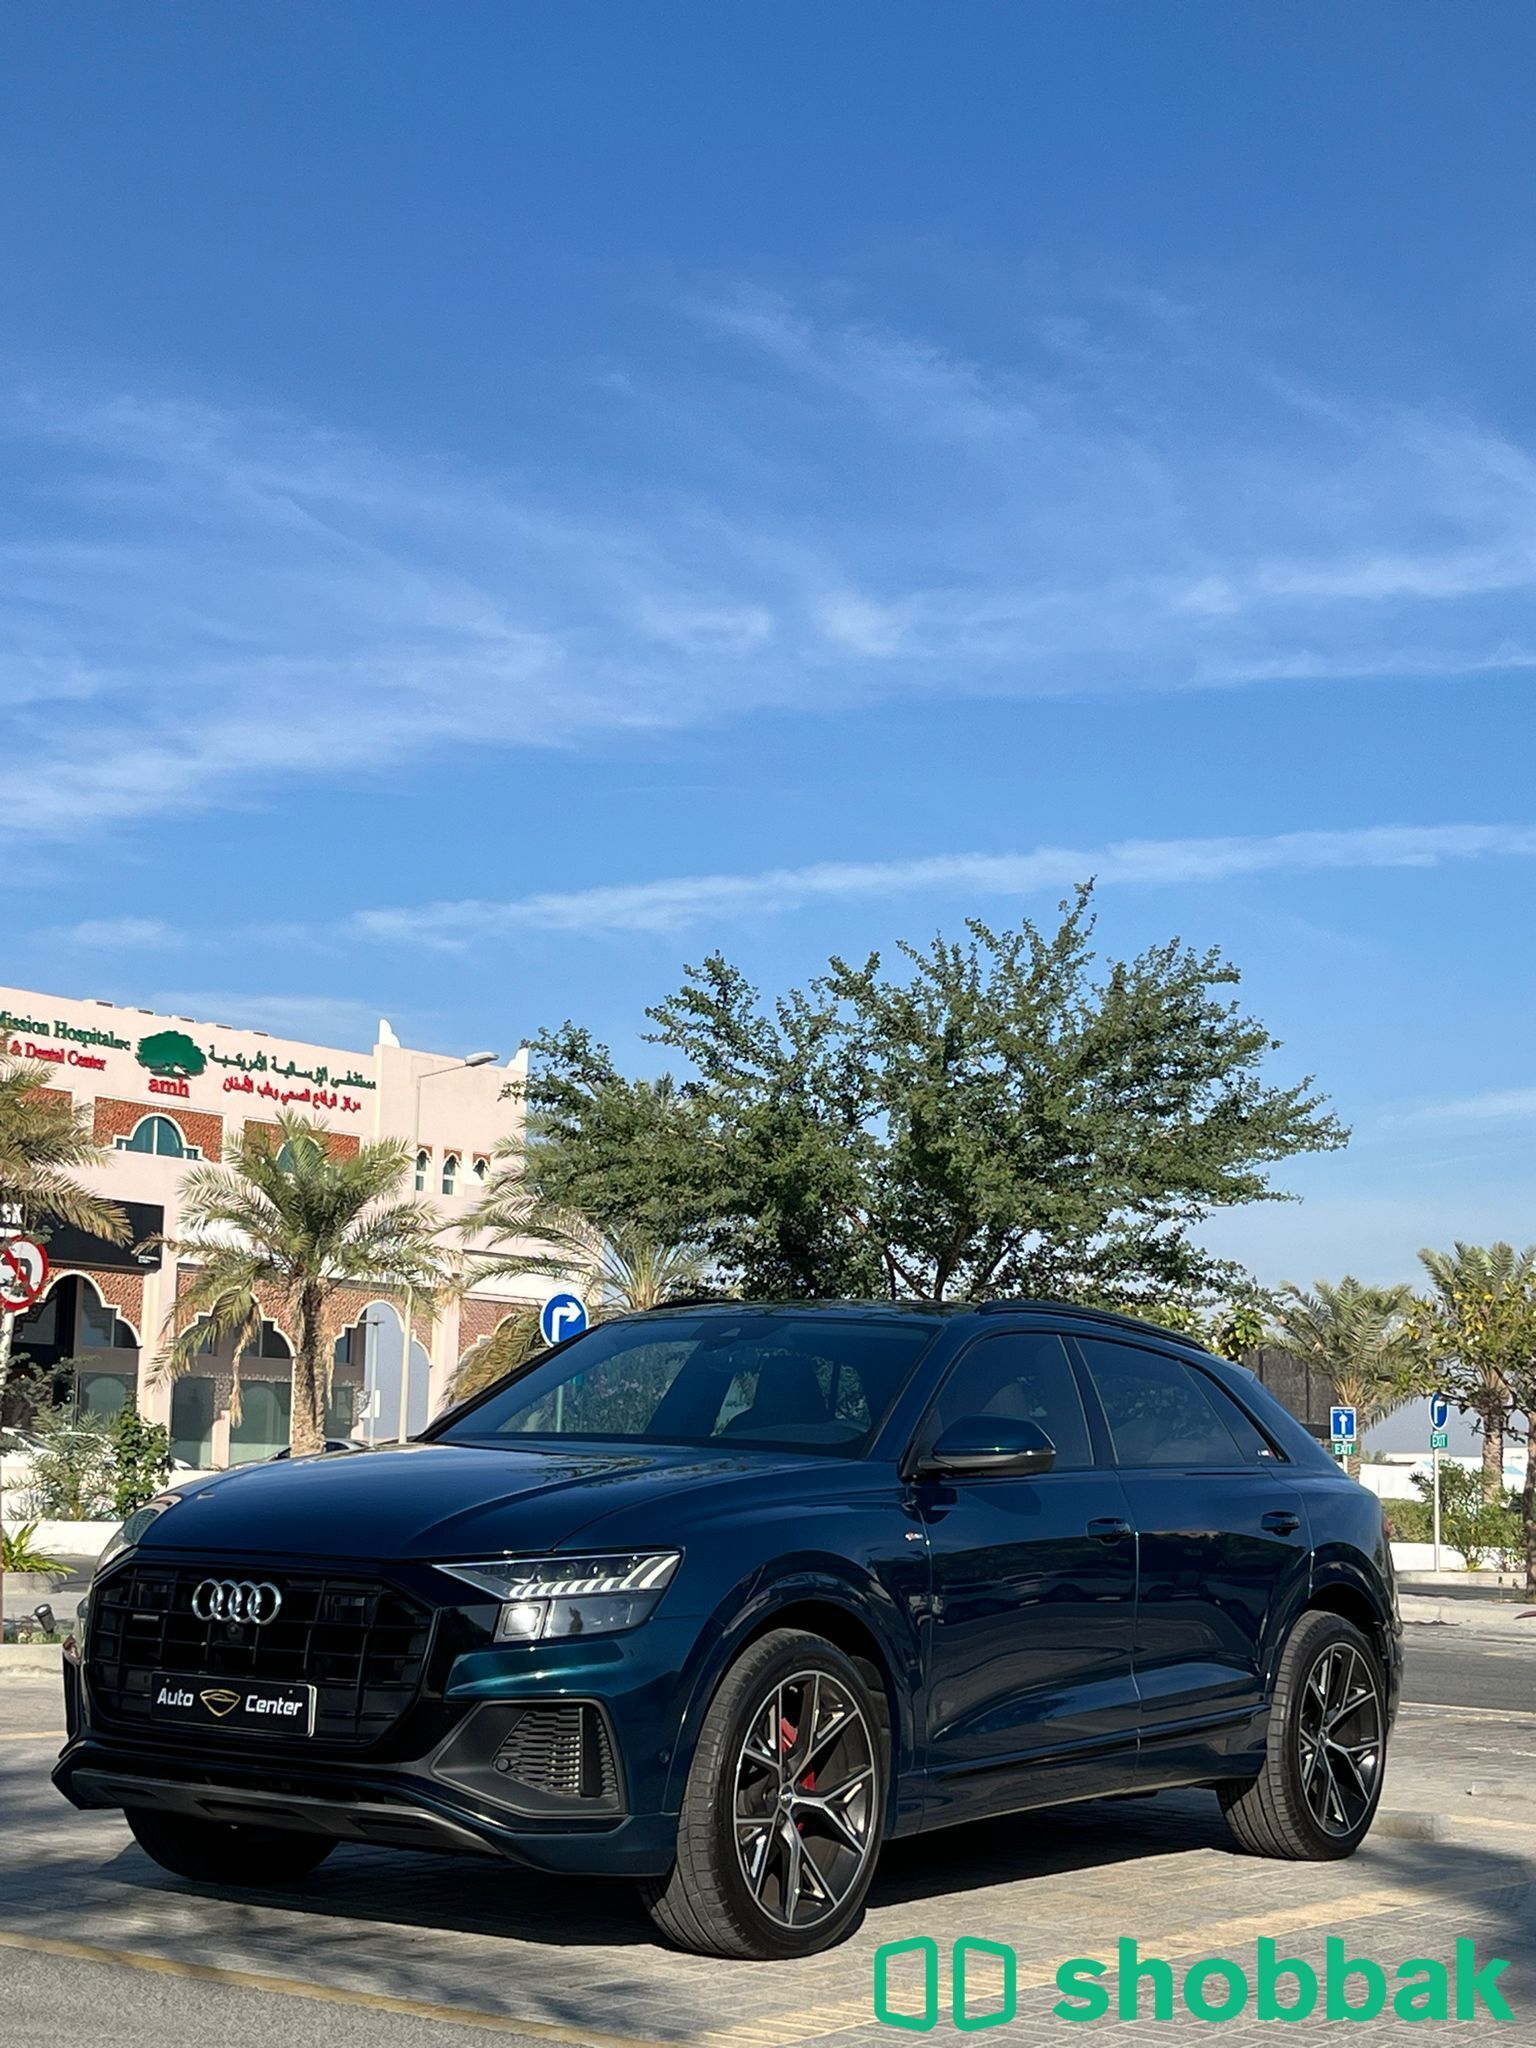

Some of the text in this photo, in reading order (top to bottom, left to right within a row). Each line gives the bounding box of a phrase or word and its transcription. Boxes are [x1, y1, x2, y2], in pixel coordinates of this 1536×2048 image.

[10, 1040, 107, 1071] & Dental Center
[148, 1076, 190, 1098] amh
[1334, 1443, 1353, 1455] EXIT
[1432, 1435, 1446, 1448] EXIT
[156, 1687, 303, 1716] Auto Center
